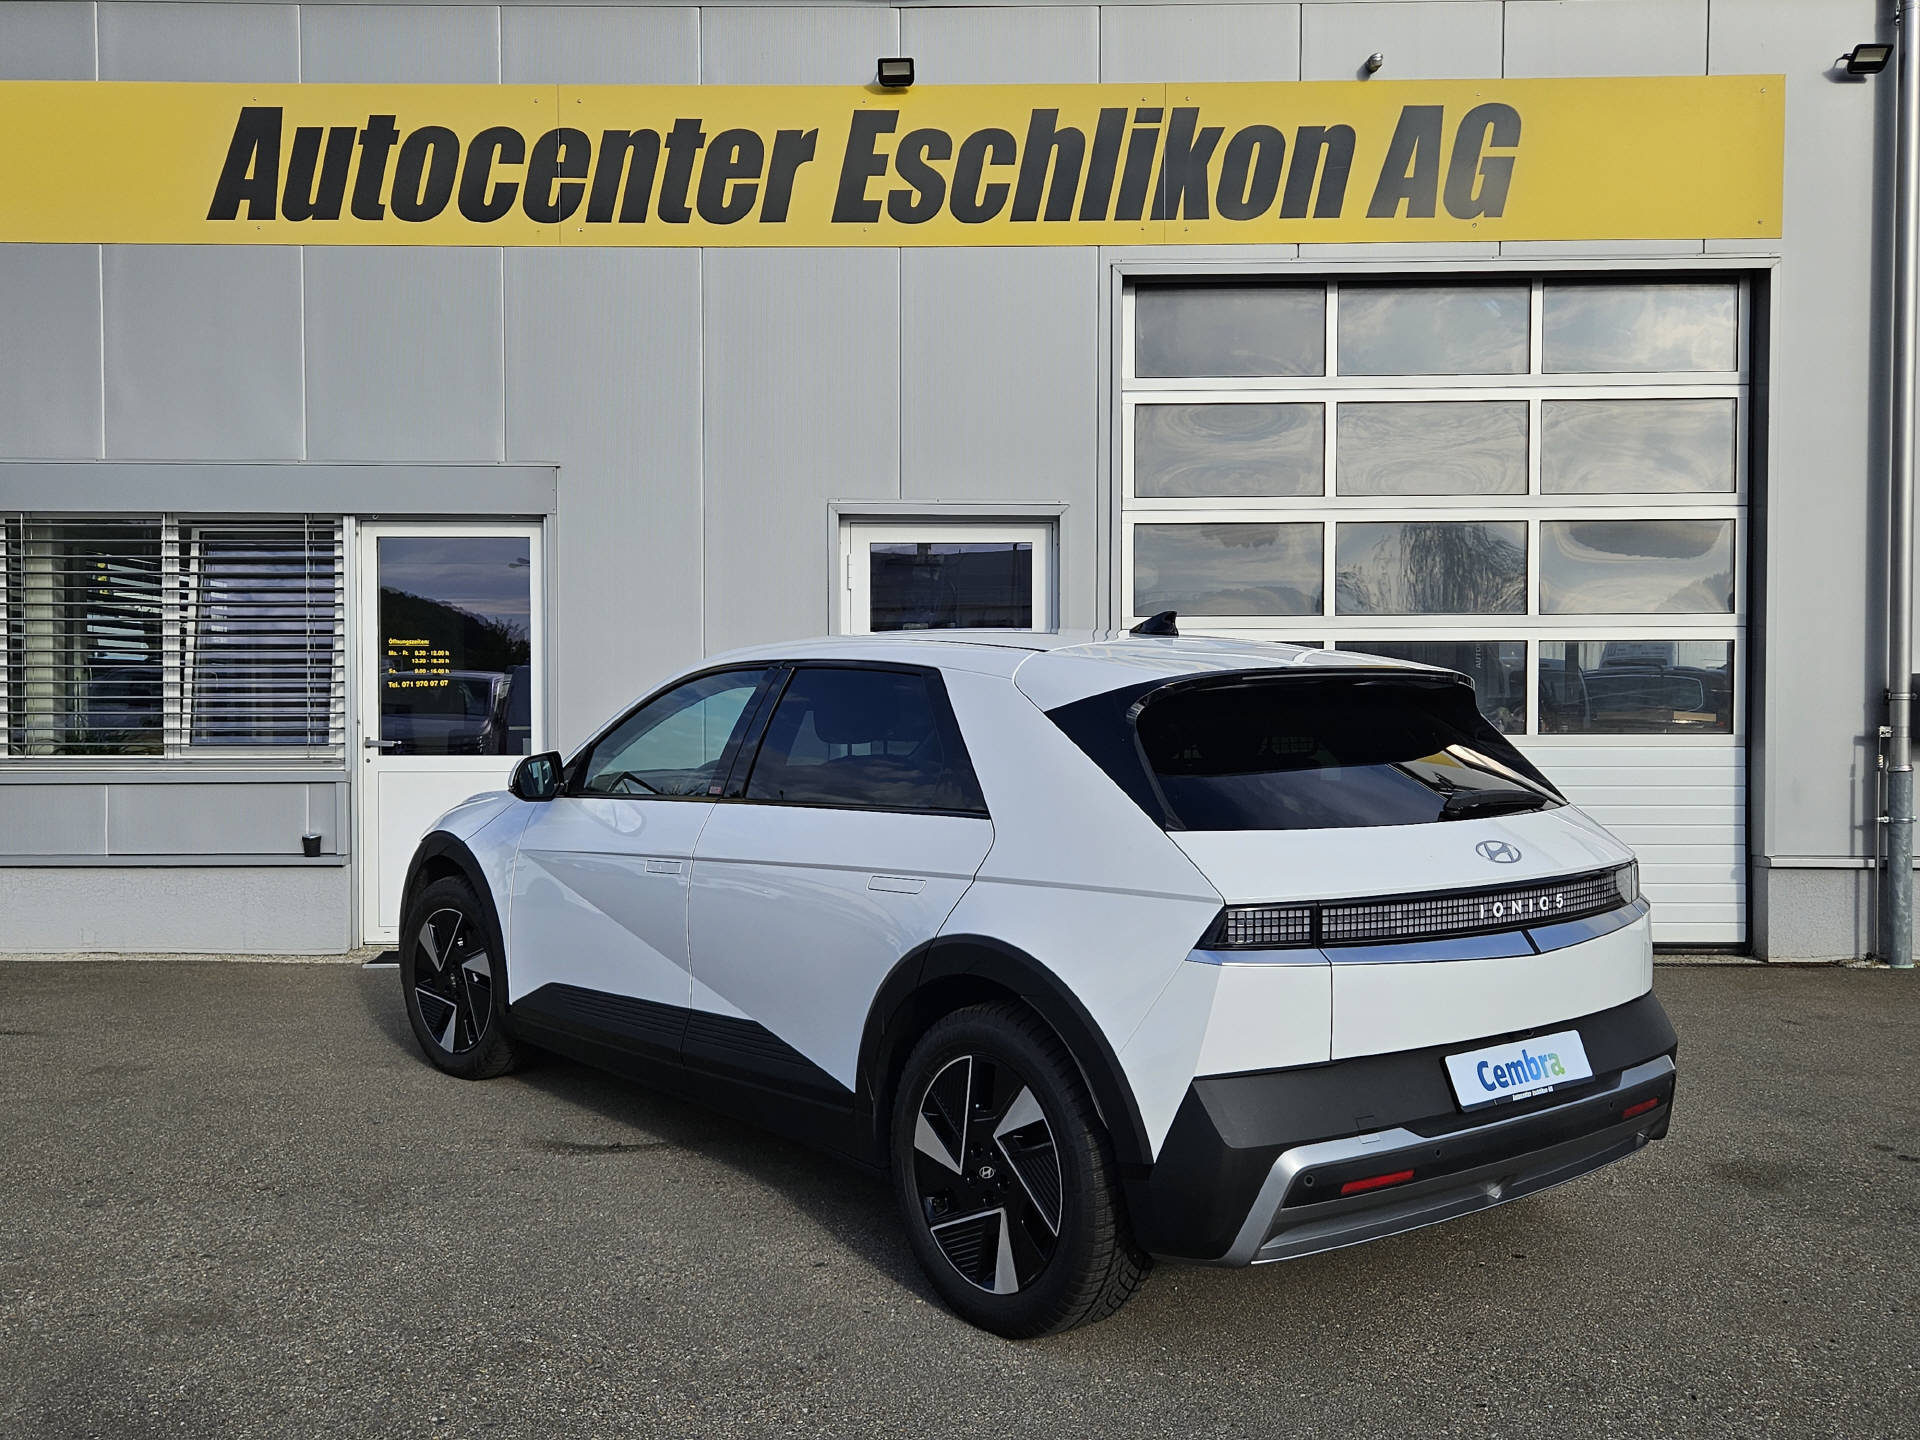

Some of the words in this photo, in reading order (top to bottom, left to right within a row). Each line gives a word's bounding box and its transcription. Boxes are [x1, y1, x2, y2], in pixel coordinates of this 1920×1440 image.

[206, 106, 819, 224] Autocenter
[831, 106, 1356, 223] Eschlikon
[1365, 103, 1522, 219] AG
[1479, 896, 1549, 919] IONIQ
[1555, 893, 1564, 908] 5
[1476, 1049, 1566, 1091] Cembra
